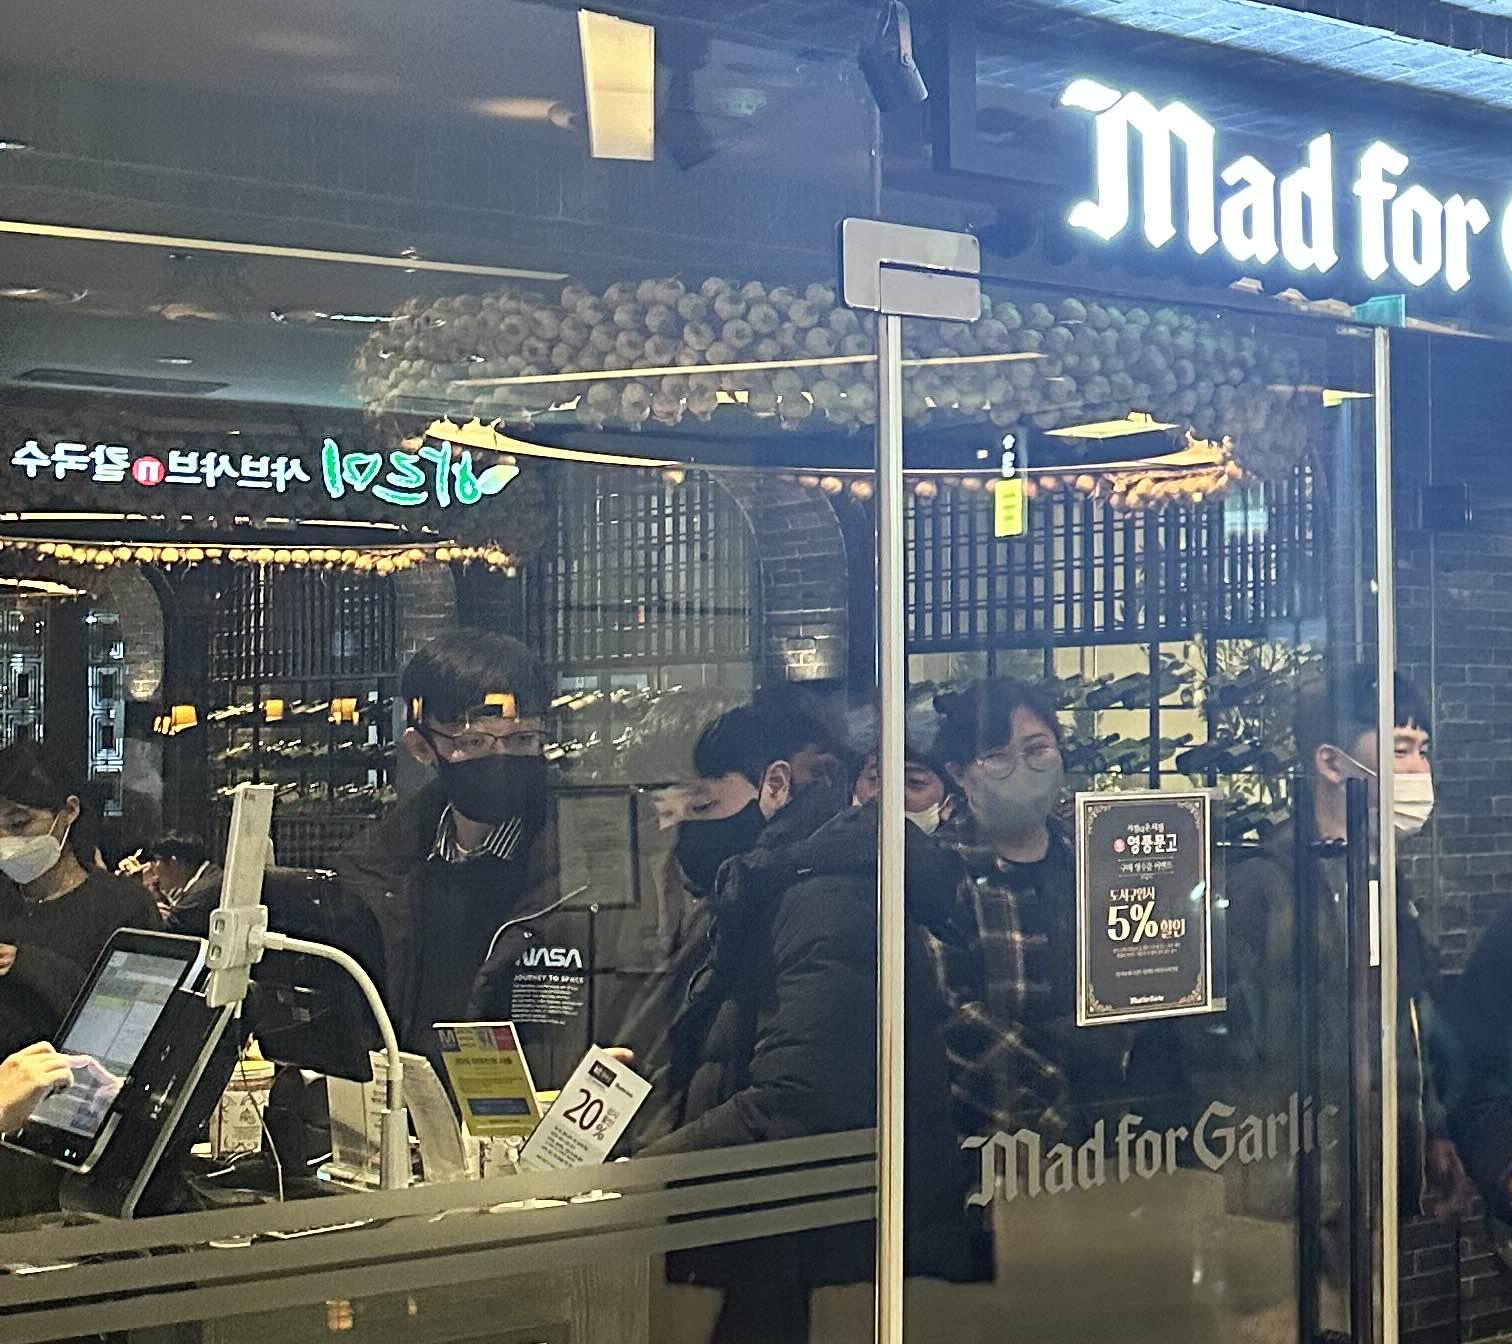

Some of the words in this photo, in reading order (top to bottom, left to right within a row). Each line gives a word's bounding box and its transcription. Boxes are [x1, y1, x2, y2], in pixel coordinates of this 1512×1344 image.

[1057, 78, 1339, 275] Mad
[1351, 139, 1489, 292] for
[1126, 833, 1178, 855] 영풍문고
[1107, 901, 1159, 943] 5%
[1159, 918, 1186, 940] 할인
[514, 947, 583, 969] NASA
[548, 974, 560, 982] TO
[960, 1118, 1106, 1208] Mad
[1115, 1111, 1190, 1183] for
[1192, 1091, 1341, 1172] Garlic
